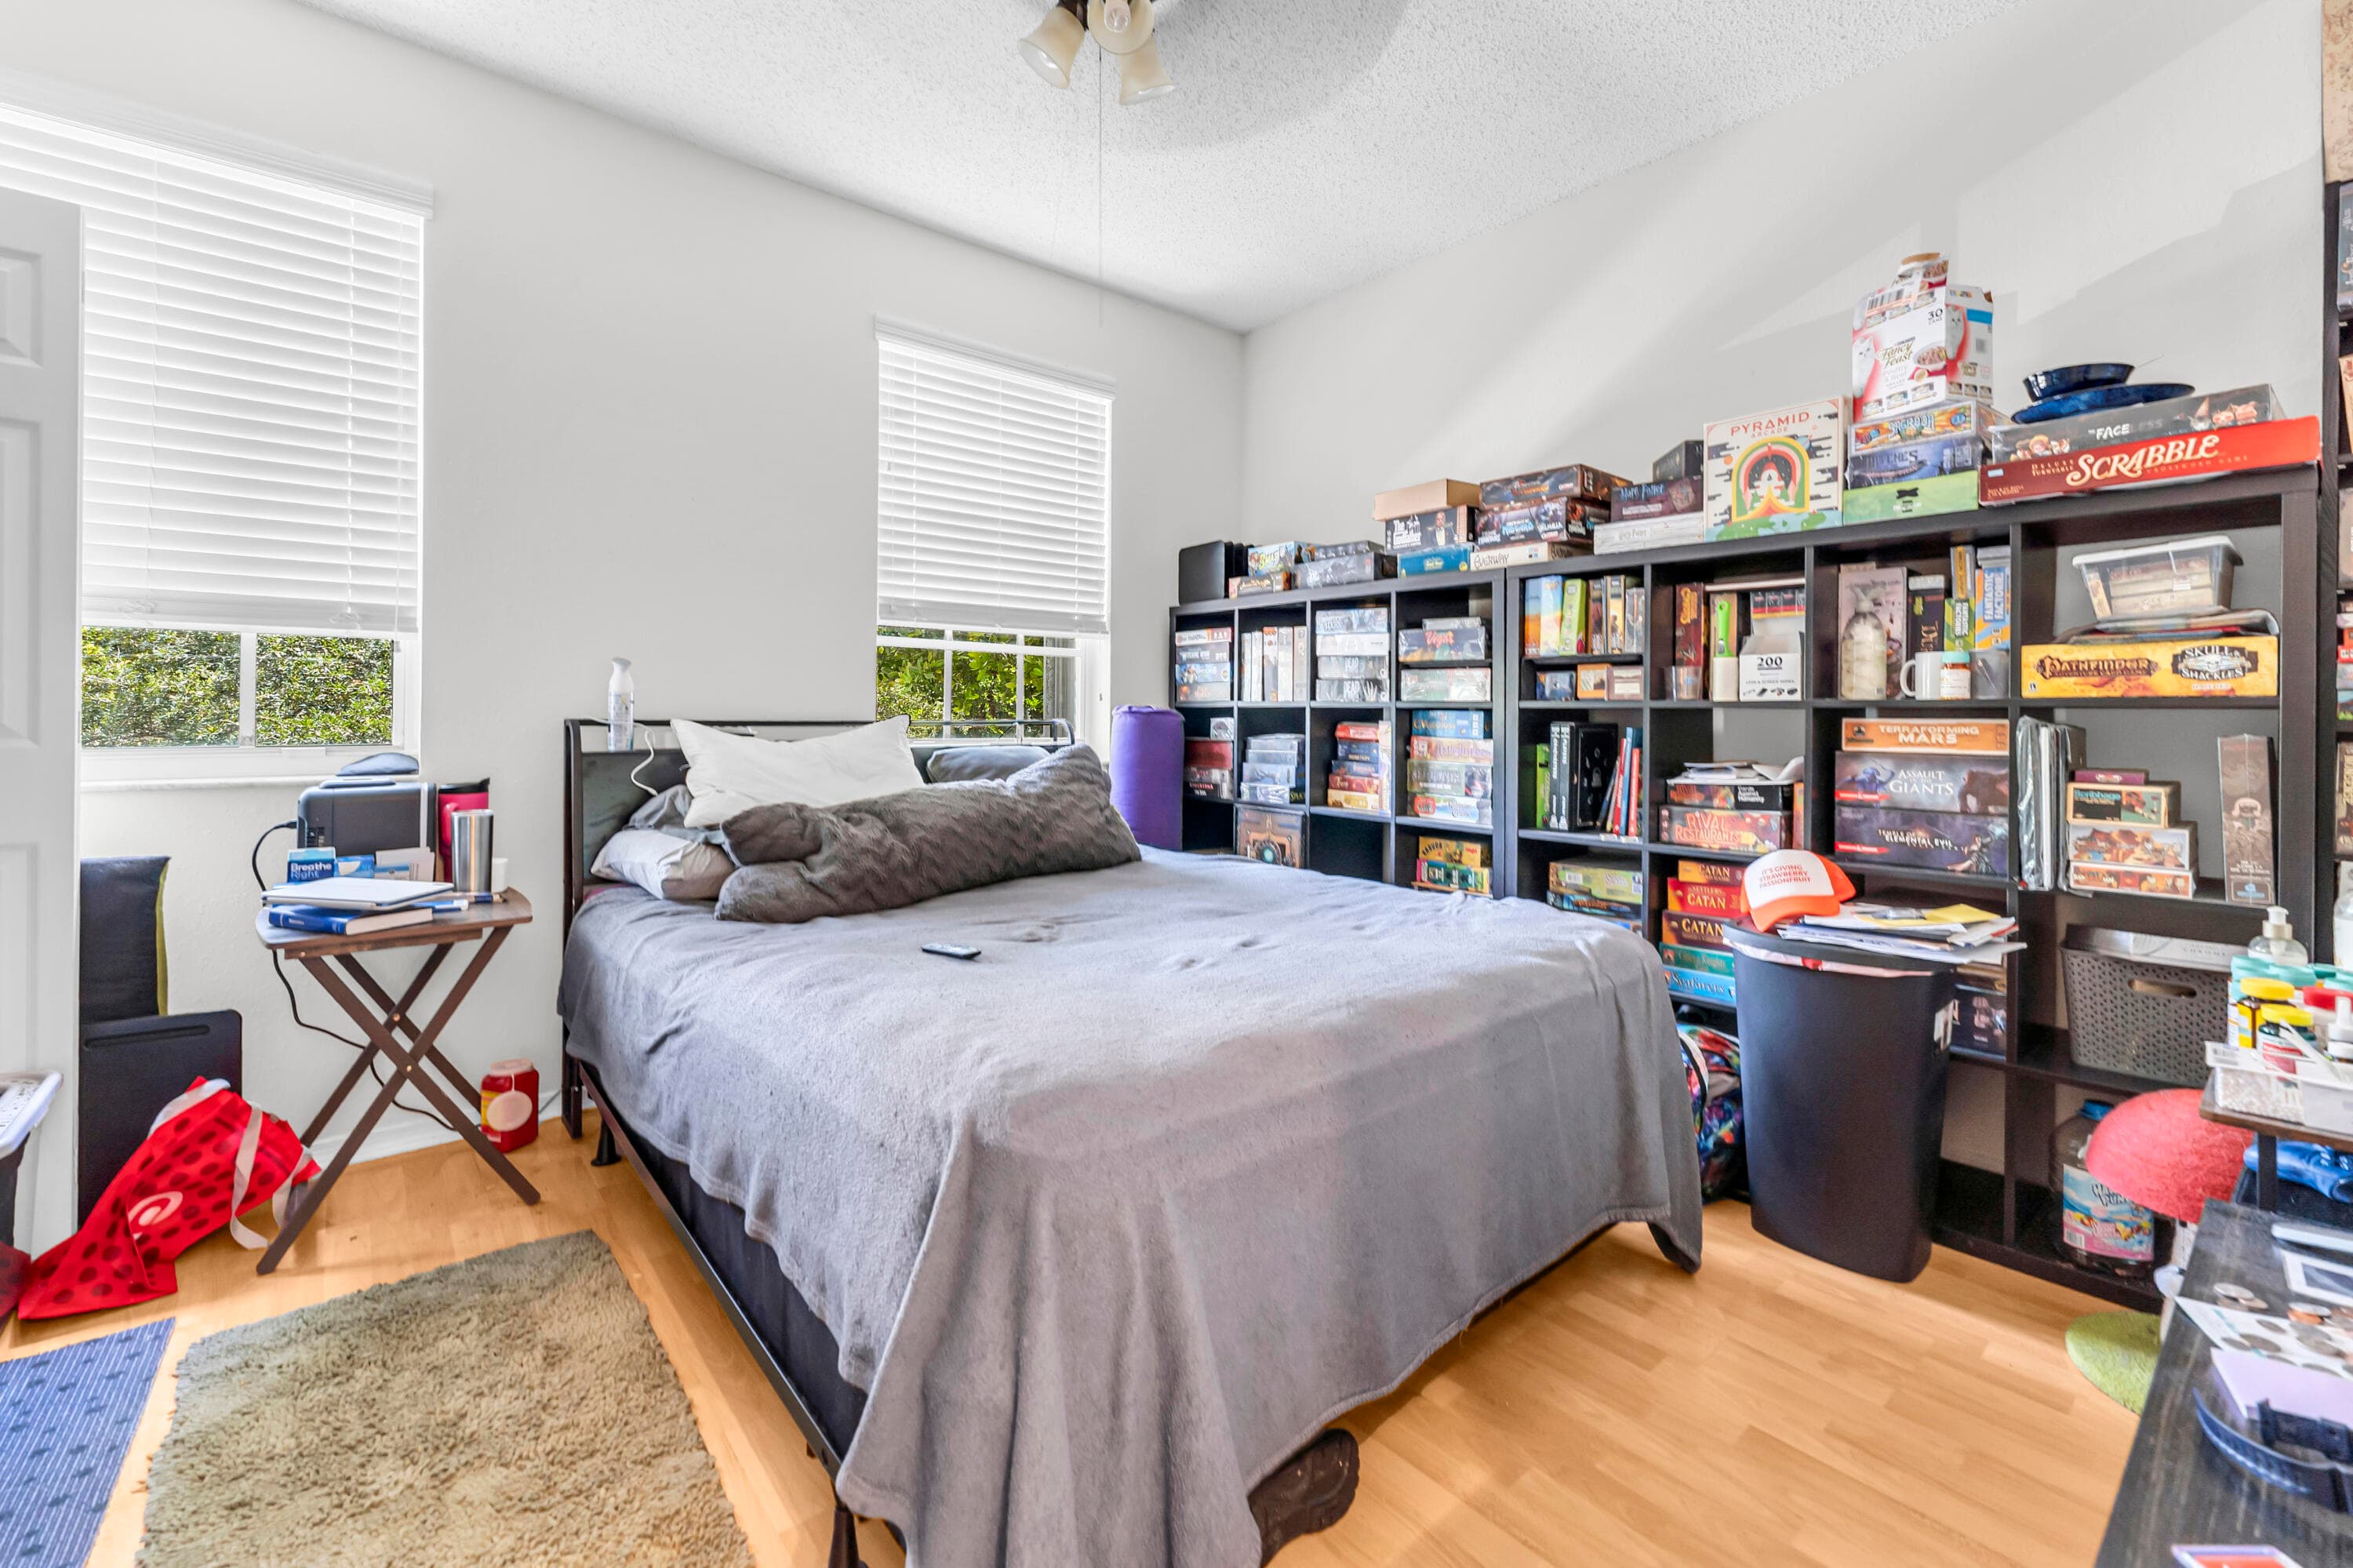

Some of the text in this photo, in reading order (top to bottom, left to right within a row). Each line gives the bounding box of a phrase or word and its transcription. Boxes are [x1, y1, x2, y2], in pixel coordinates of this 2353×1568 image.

[1927, 307, 1943, 321] 30
[1877, 341, 1914, 361] Fancy
[1883, 351, 1913, 369] Feast
[1731, 411, 1809, 436] PYRAMID
[1751, 427, 1788, 438] ARCADE
[2066, 435, 2220, 486] SCRABBLE
[1620, 482, 1665, 501] Harry Potter
[1393, 519, 1406, 533] The
[1393, 530, 1422, 547] Godfather
[1984, 573, 1995, 621] FANTASTIC
[2184, 645, 2228, 658] SKULL
[1757, 657, 1783, 667] 200
[2044, 657, 2149, 679] PATHFINDER
[2181, 668, 2244, 681] SHACKLES
[1878, 725, 1979, 735] TERRAFORMING
[1898, 733, 1958, 744] MARS
[1898, 769, 1946, 780] ASSAULT
[1889, 780, 1954, 795] GIANTS
[1738, 795, 1764, 804] Humanity
[1686, 809, 1727, 830] RIVAL
[1675, 824, 1740, 842] RESTAURANTS
[290, 862, 332, 872] Breathe
[1700, 864, 1730, 879] CATAN
[290, 870, 320, 879] Right
[1760, 870, 1808, 882] STRAWBERRY
[1759, 877, 1811, 889] PASSIONFRUIT
[1687, 893, 1726, 909] CATAN
[1682, 918, 1724, 937] CATAN
